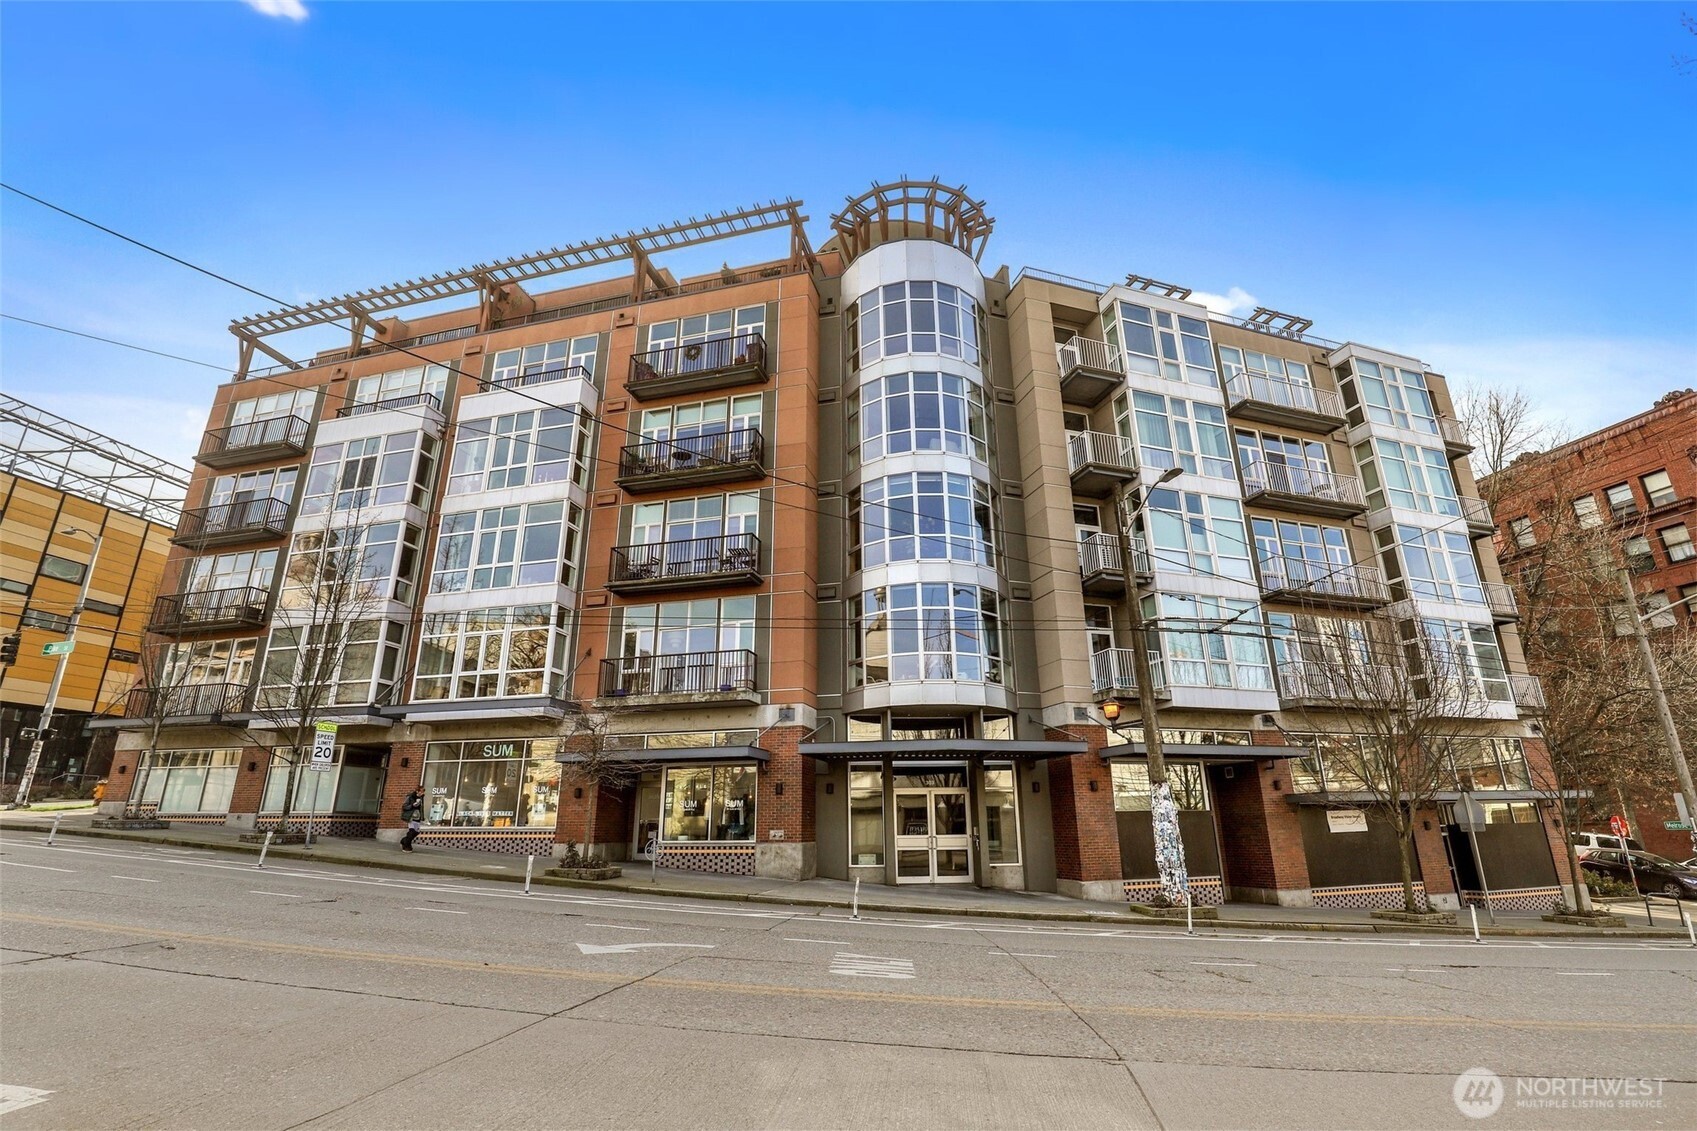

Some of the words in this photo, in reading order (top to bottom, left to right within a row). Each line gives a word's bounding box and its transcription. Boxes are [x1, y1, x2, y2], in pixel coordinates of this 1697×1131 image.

[314, 746, 332, 759] 20
[483, 744, 514, 757] SUM
[432, 787, 448, 795] SUM
[533, 785, 549, 793] SUM
[680, 800, 698, 808] SUM
[725, 799, 744, 807] SUM
